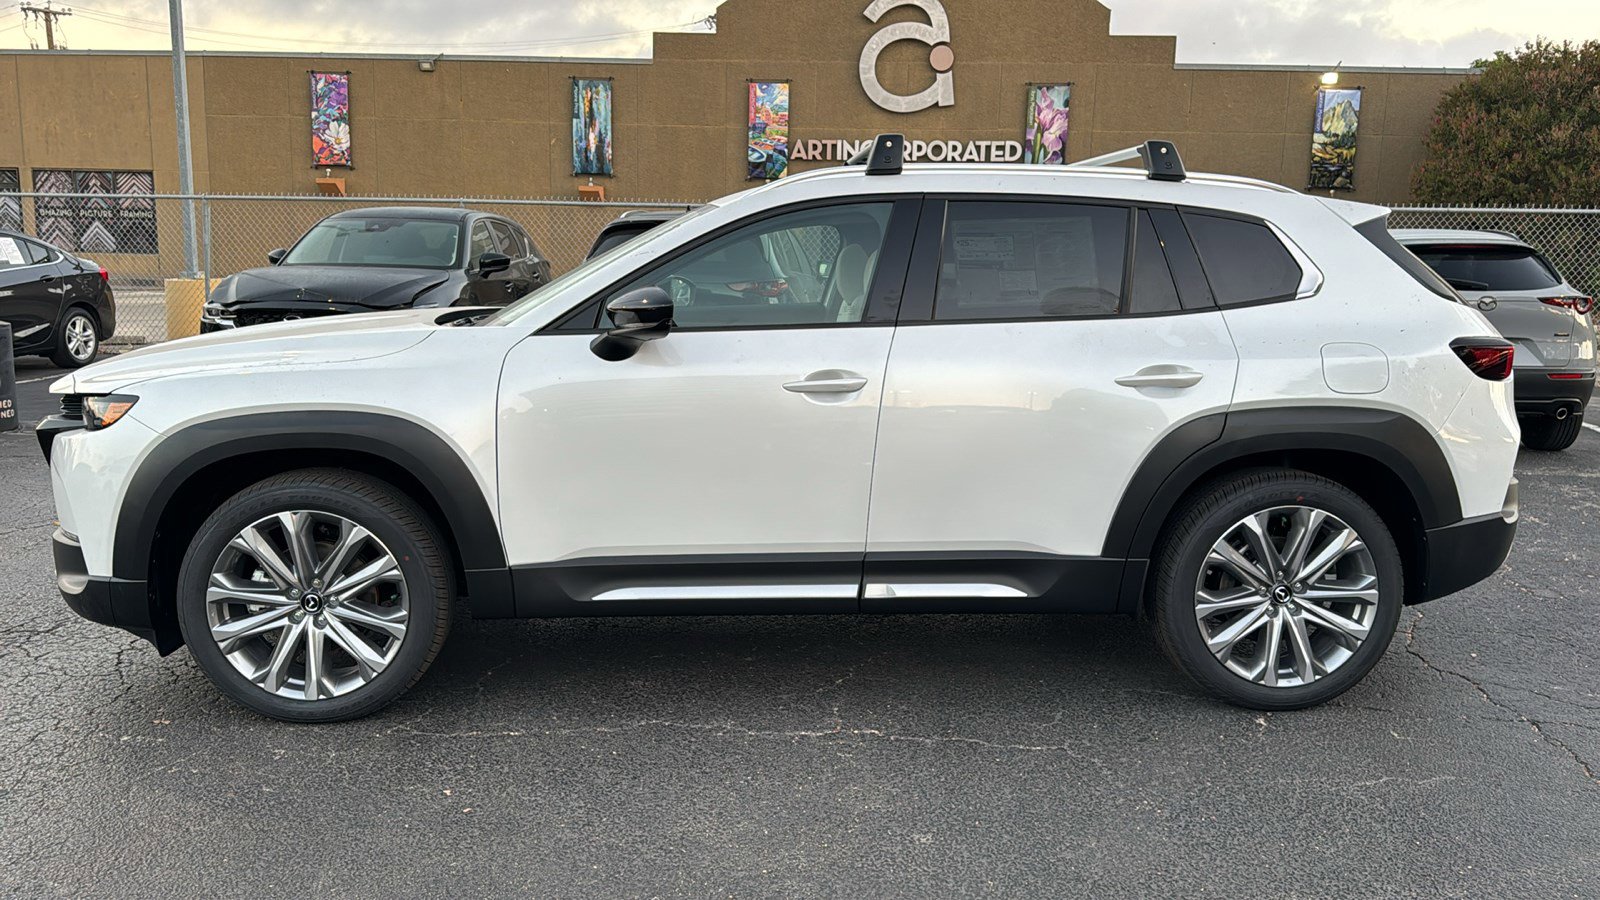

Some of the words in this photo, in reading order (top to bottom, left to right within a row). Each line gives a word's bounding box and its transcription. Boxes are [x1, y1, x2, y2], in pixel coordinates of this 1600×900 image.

[790, 139, 1022, 162] ARTINRPORATED
[80, 209, 112, 218] PICTURE
[120, 210, 153, 219] FRAMING
